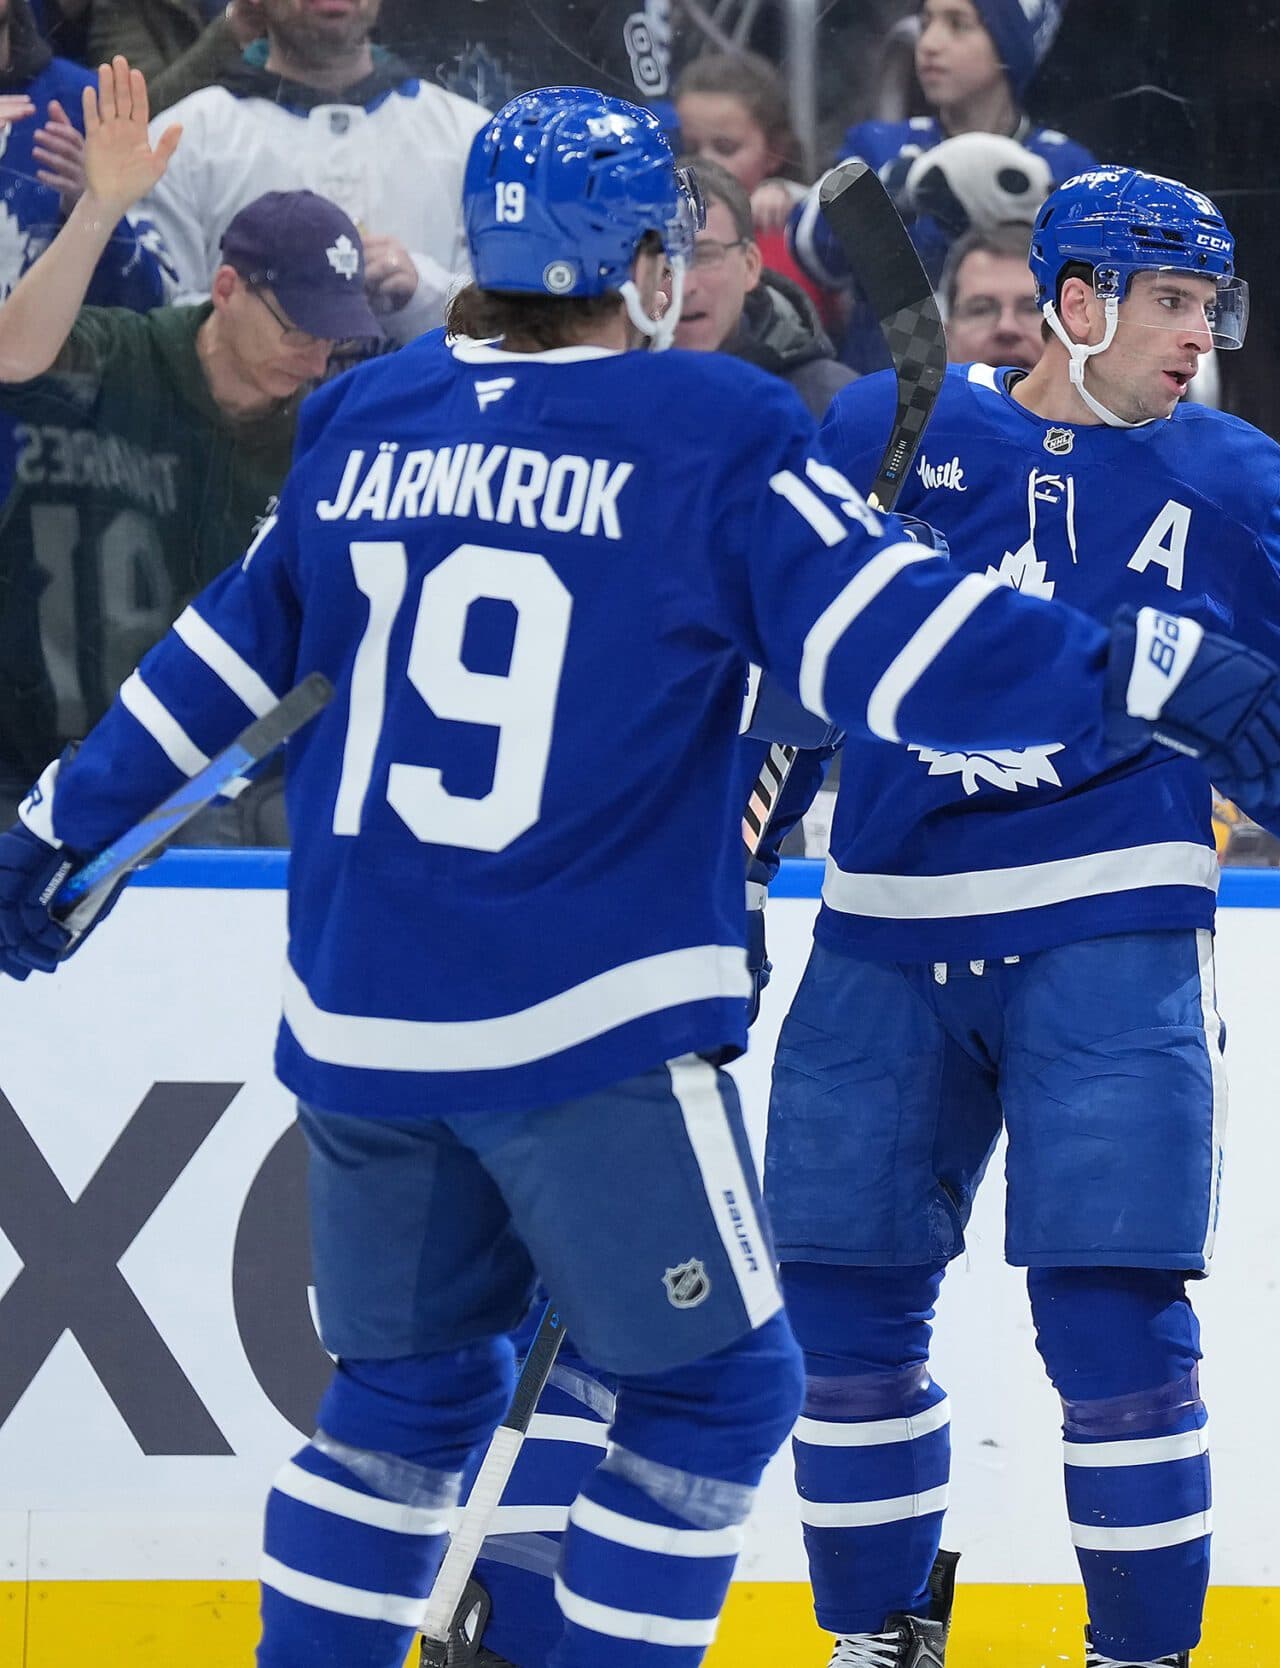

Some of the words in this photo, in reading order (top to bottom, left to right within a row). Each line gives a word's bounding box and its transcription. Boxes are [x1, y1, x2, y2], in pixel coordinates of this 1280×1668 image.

[495, 181, 526, 223] 19
[1196, 233, 1231, 252] CCM
[316, 441, 634, 540] JÄRNKROK
[916, 454, 968, 492] Milk
[1127, 500, 1192, 590] A
[333, 541, 573, 853] 19
[722, 1189, 758, 1273] BAUER
